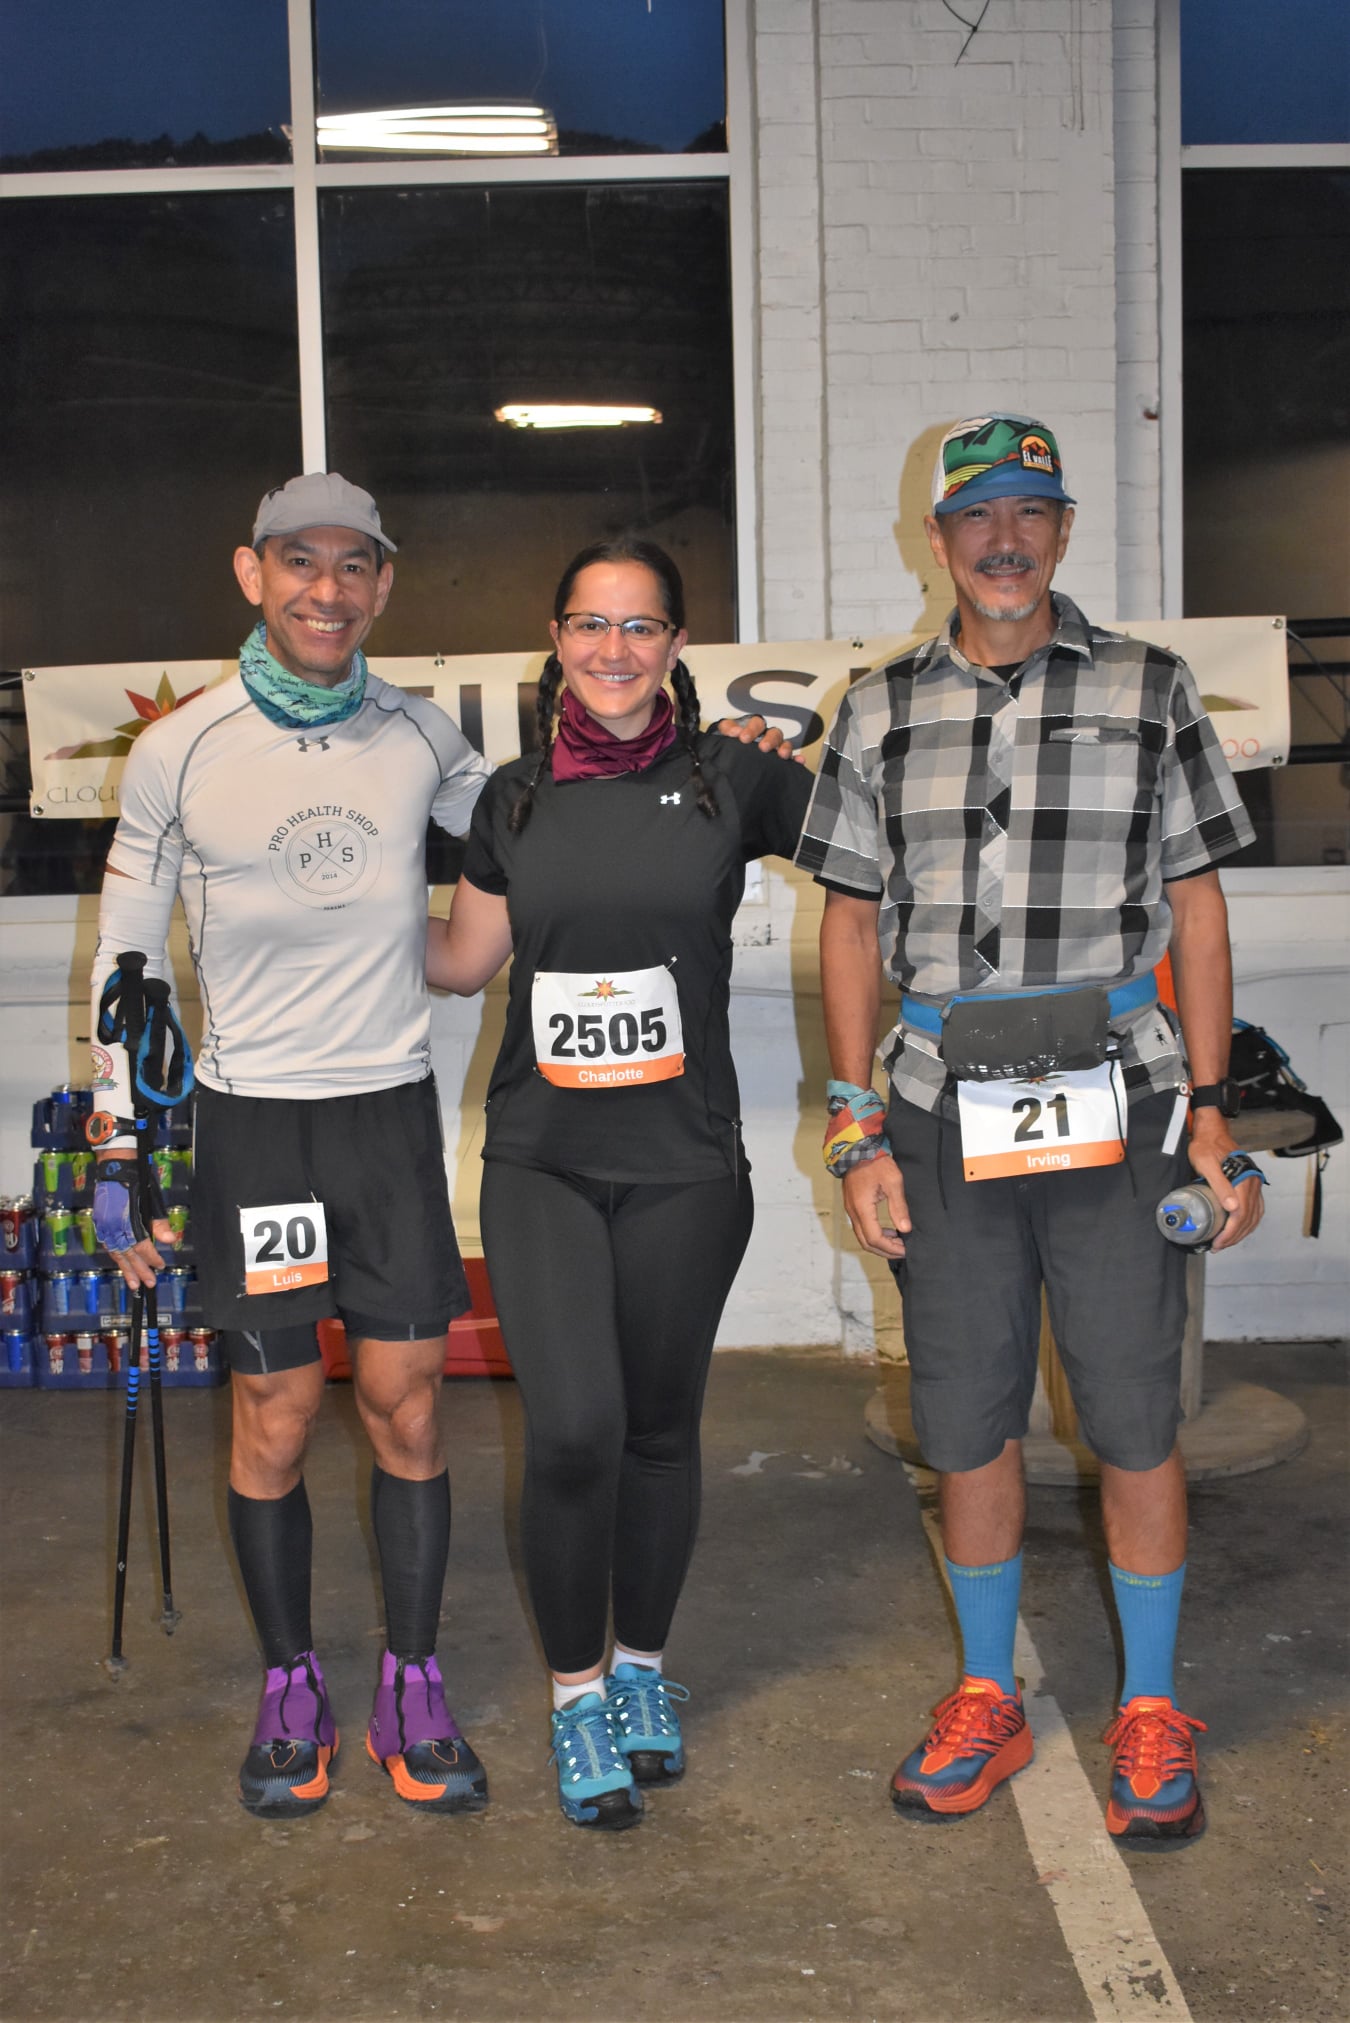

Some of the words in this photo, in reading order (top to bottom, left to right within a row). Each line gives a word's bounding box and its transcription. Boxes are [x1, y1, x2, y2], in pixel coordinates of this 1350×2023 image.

[46, 784, 119, 804] CLOU
[267, 825, 290, 853] PRO
[286, 805, 344, 828] HEALTH
[345, 808, 380, 838] SHOP
[316, 831, 333, 849] H
[299, 852, 313, 869] P
[341, 846, 355, 863] S
[548, 1006, 667, 1059] 2505
[577, 1069, 645, 1084] Charlotte
[1011, 1092, 1071, 1143] 21
[1026, 1152, 1072, 1169] Irving
[253, 1215, 317, 1264] 20
[272, 1271, 303, 1288] Luis
